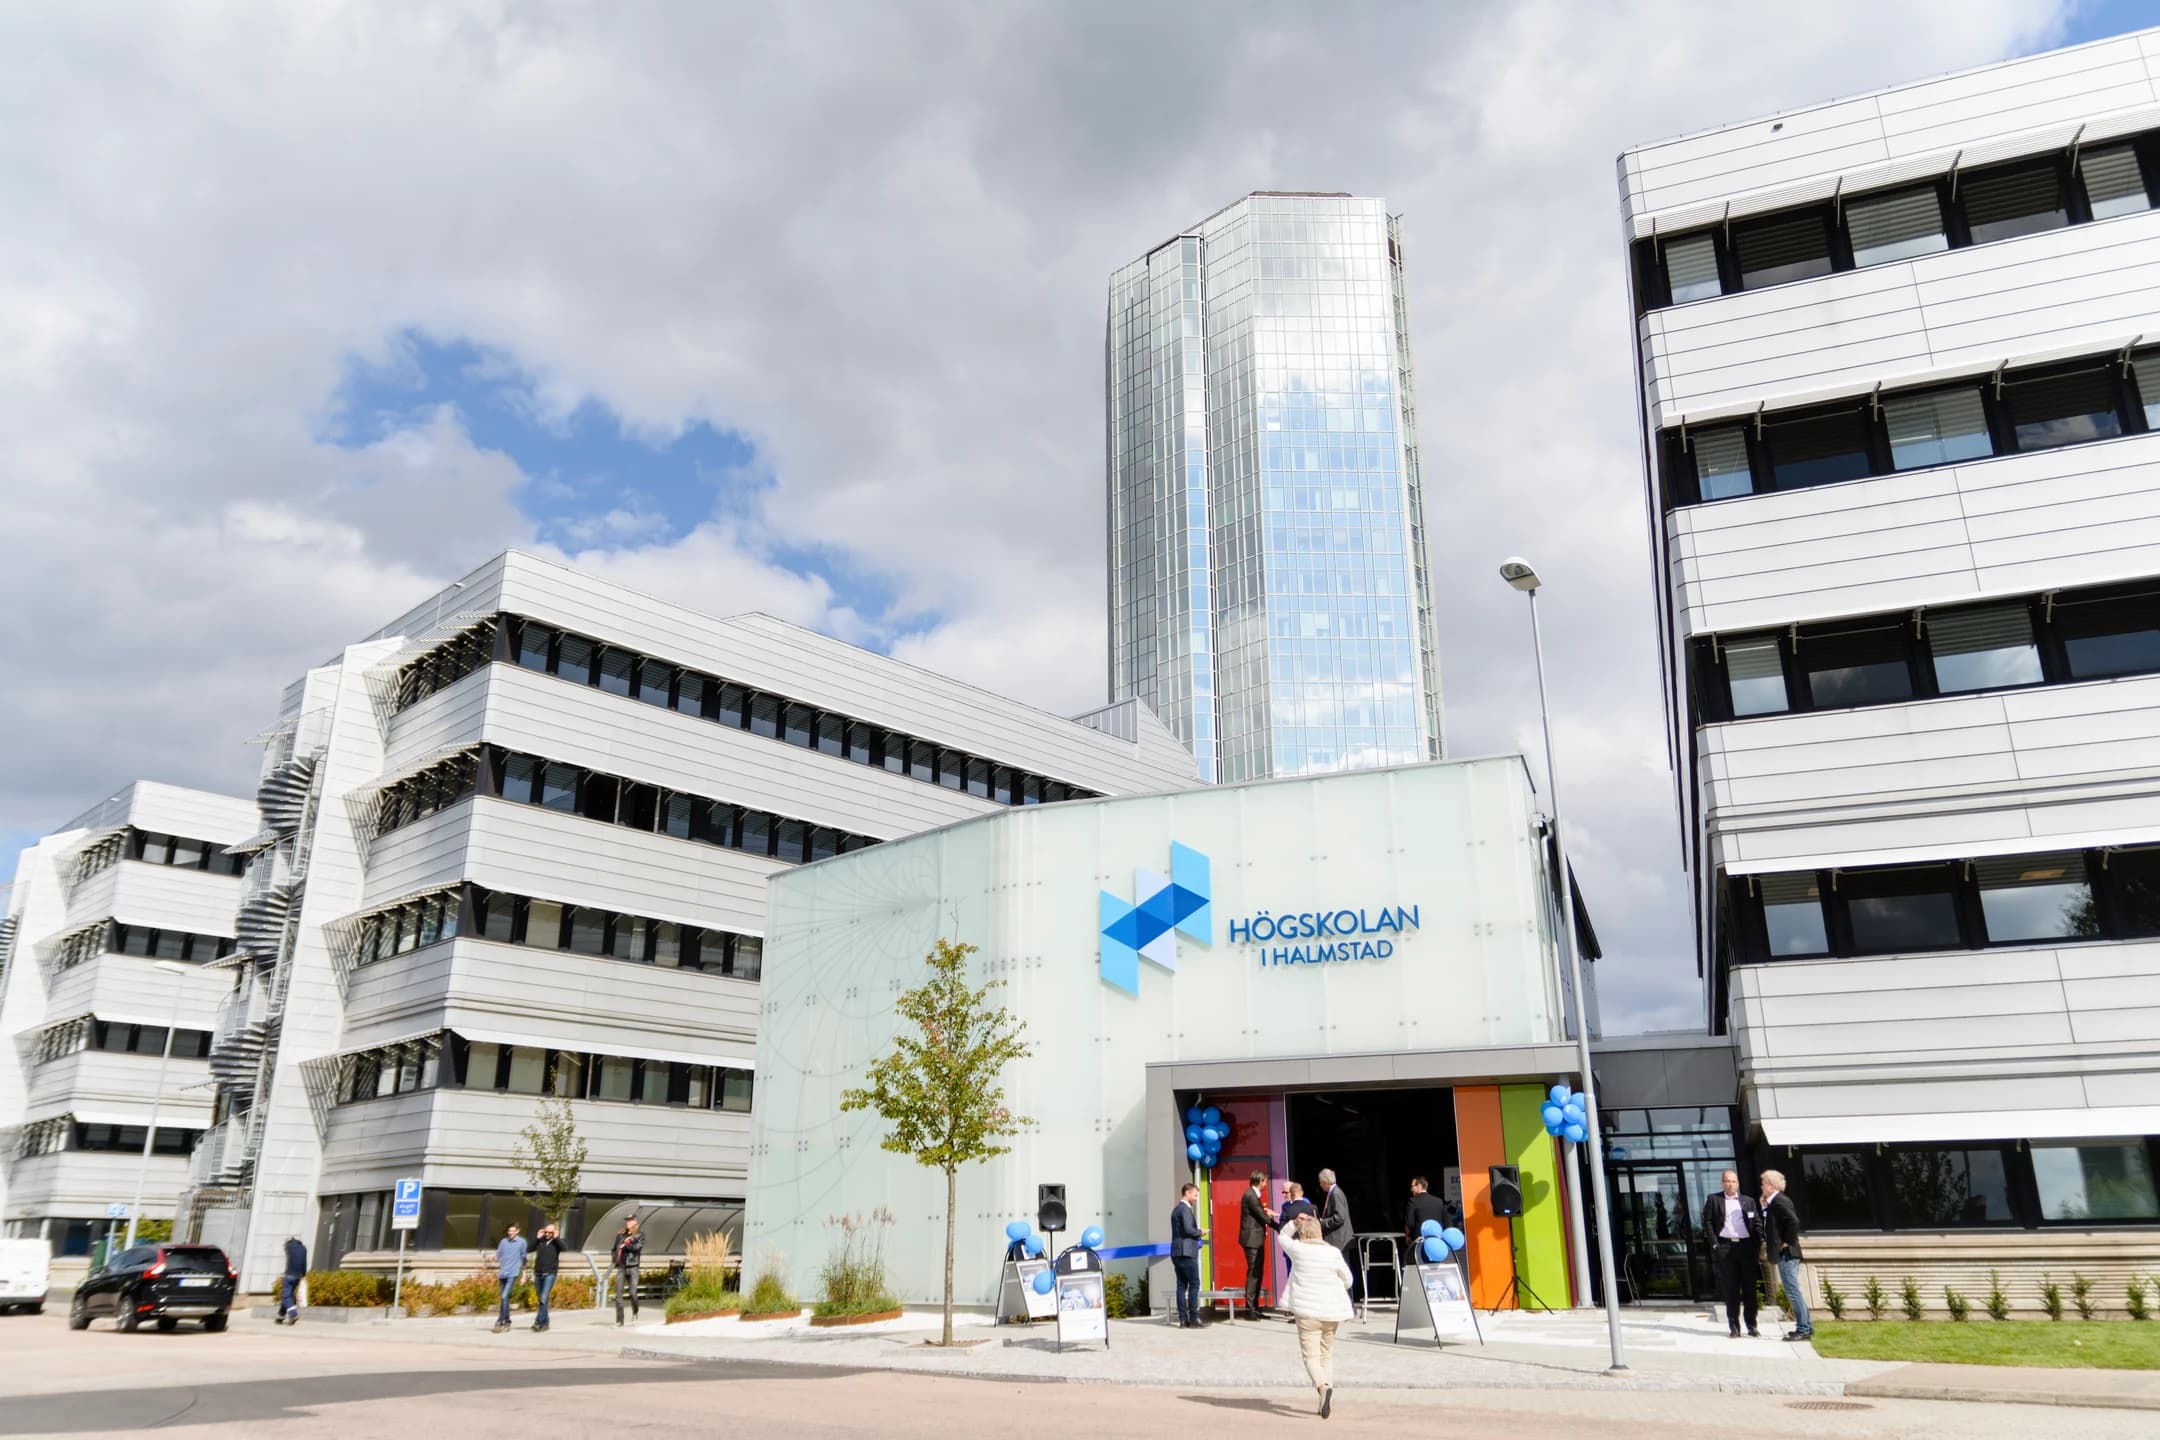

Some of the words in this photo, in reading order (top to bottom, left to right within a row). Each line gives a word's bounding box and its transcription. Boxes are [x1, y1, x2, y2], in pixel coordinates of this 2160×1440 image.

[1229, 904, 1420, 943] HÖGSKOLAN
[1261, 948, 1267, 966] I
[1273, 940, 1394, 966] HALMSTAD
[402, 1182, 416, 1199] P
